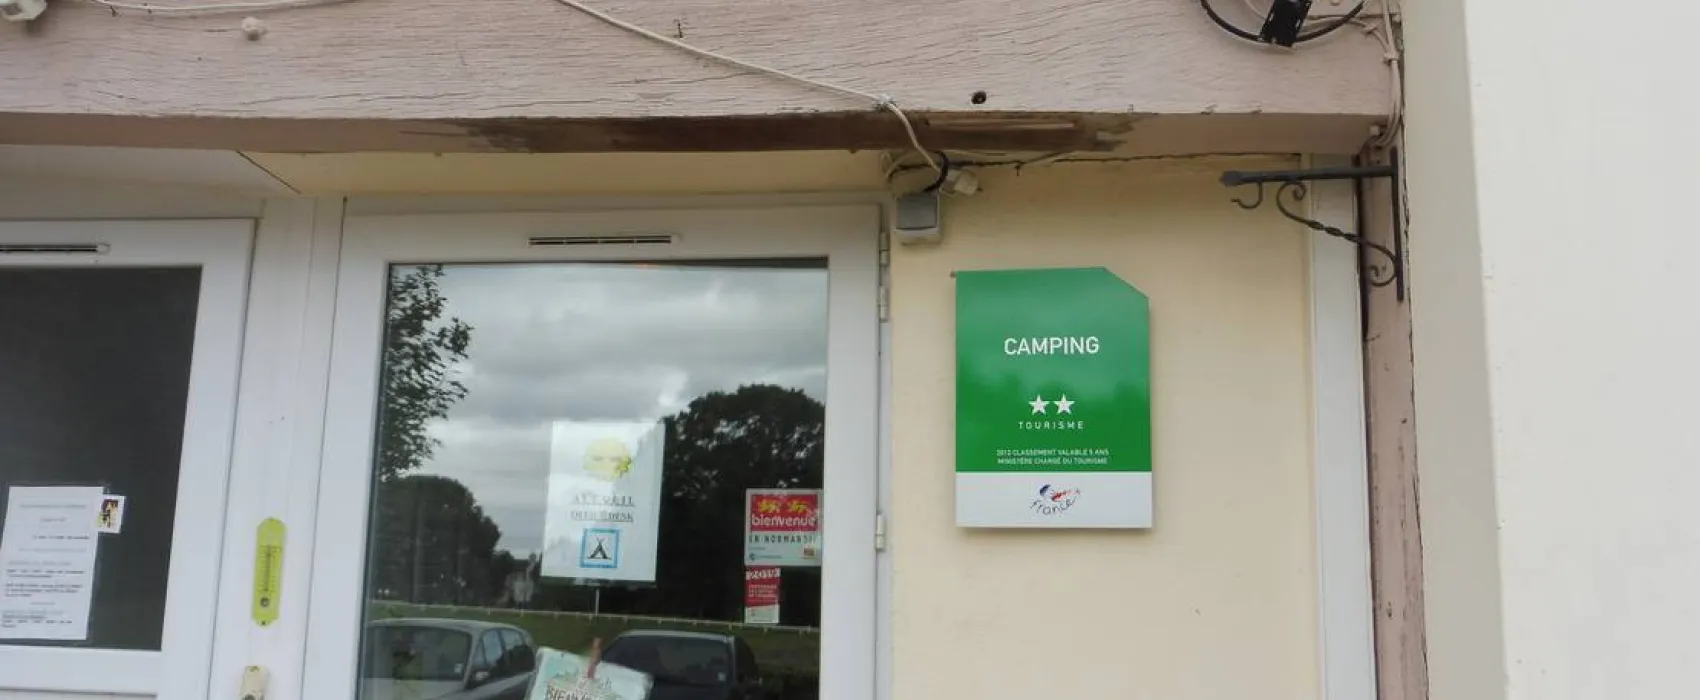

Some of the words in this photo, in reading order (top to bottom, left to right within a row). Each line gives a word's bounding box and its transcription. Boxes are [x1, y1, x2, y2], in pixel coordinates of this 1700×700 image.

[1004, 336, 1100, 356] CAMPING
[1018, 420, 1084, 430] TOURISME
[1012, 449, 1056, 457] CLASSEMENT
[1058, 448, 1088, 456] VALABLE
[1094, 448, 1110, 456] ANS
[1062, 457, 1073, 465] DU
[1074, 457, 1108, 465] TOURISME
[751, 513, 817, 527] bienvenue
